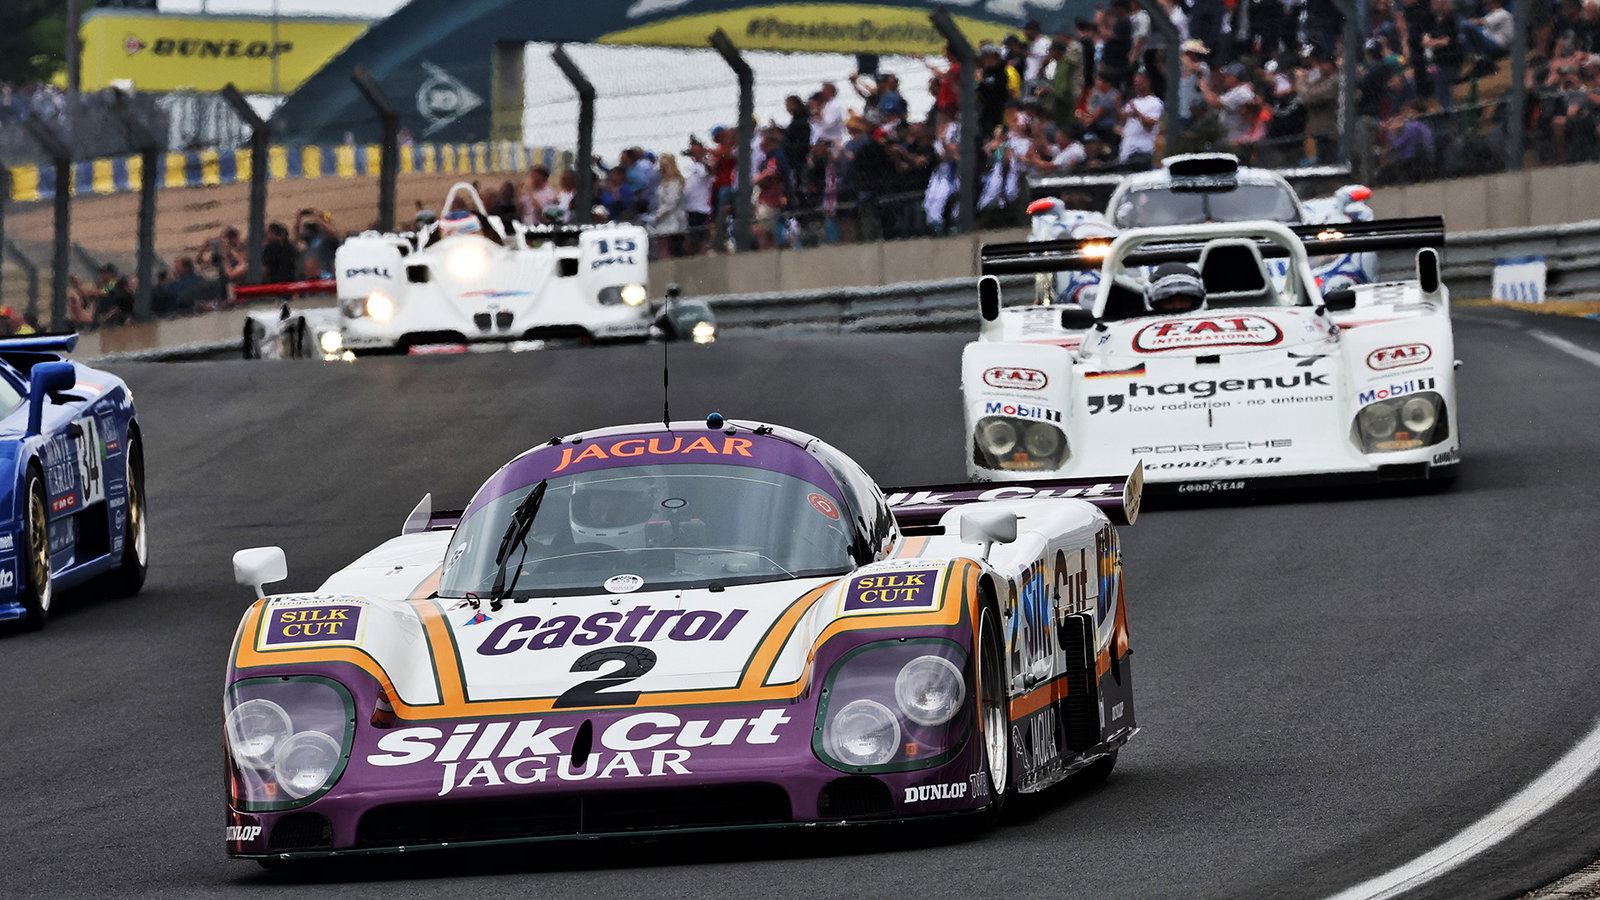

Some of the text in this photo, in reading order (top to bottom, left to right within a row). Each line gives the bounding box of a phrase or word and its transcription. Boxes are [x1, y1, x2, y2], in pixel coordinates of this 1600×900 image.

[153, 38, 294, 58] DUNLOP
[590, 238, 637, 256] 15
[345, 266, 392, 279] DELL
[1151, 332, 1266, 346] INTERNATIONAL
[1128, 371, 1331, 399] hagenuk
[1358, 379, 1415, 404] Mobil
[984, 402, 1042, 419] Mobil
[1128, 402, 1155, 414] low
[1160, 396, 1232, 412] radiation
[1247, 397, 1267, 406] no
[1271, 393, 1335, 405] antenna
[552, 436, 754, 473] JAGUAR
[1132, 438, 1293, 454] PORSCHE
[70, 420, 100, 502] 34
[977, 482, 1114, 502] Cut
[52, 495, 75, 512] TMC
[857, 573, 926, 590] SILK
[859, 587, 920, 603] CUT
[280, 609, 350, 623] SILK
[282, 622, 343, 637] CUT
[477, 606, 748, 656] Castrol
[551, 646, 658, 709] 2
[367, 708, 792, 767] Silk Cut
[437, 750, 692, 797] JAGUAR
[904, 782, 967, 803] DUNLOP
